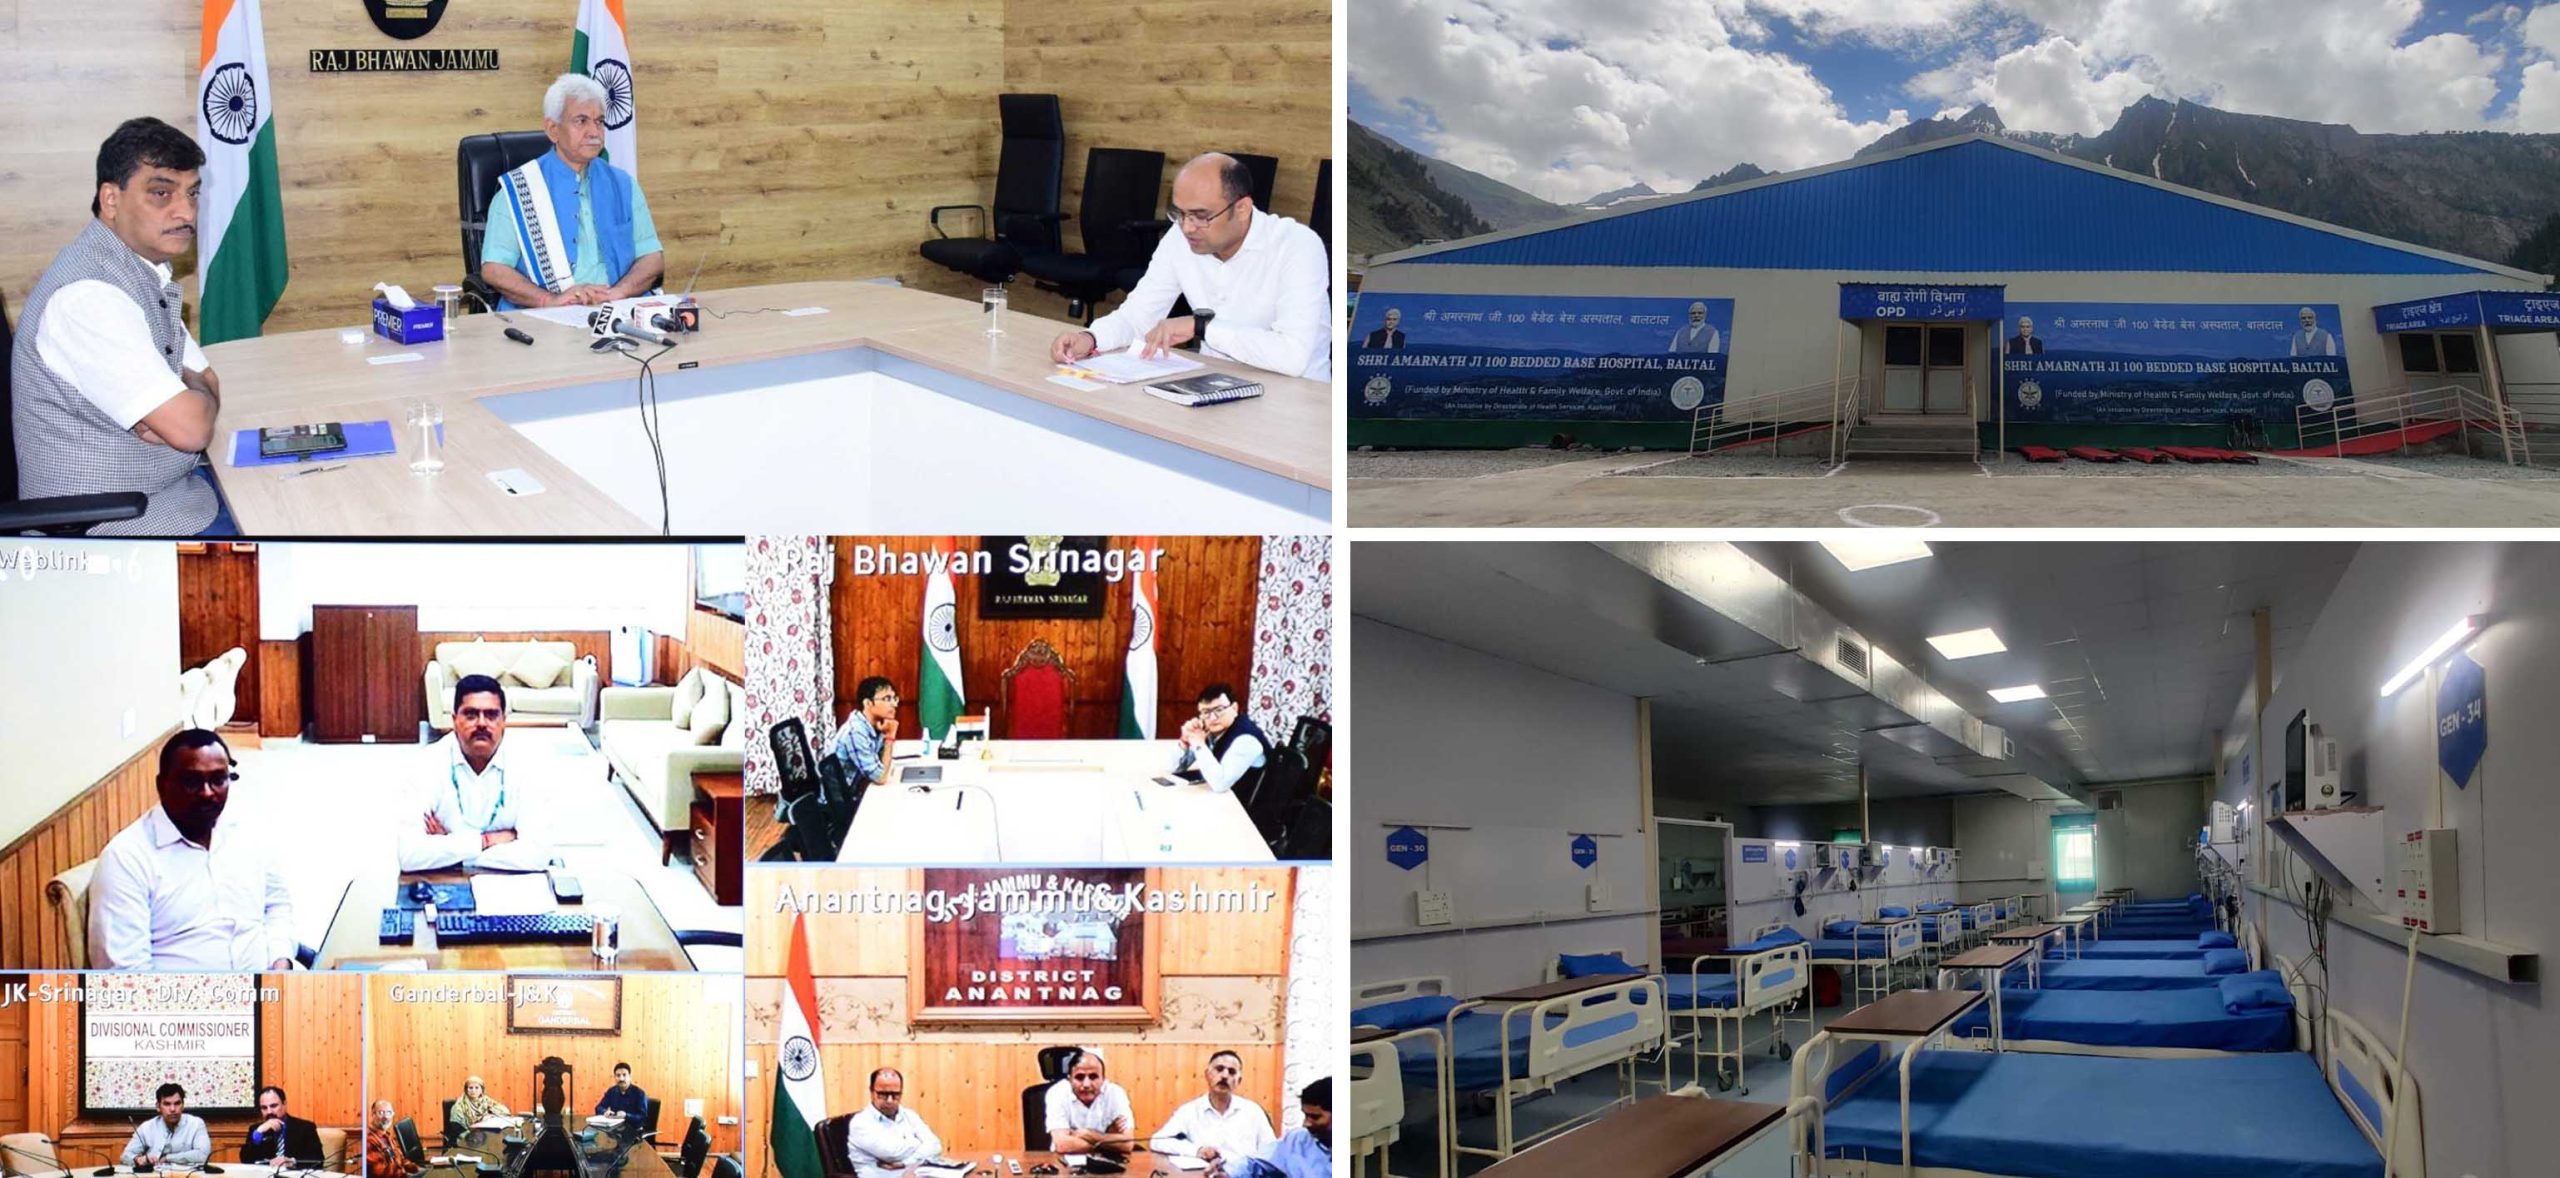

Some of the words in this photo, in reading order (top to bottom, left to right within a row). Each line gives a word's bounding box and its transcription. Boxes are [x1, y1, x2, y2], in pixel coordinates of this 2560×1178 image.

[312, 50, 350, 71] RAJ
[355, 50, 430, 71] BHAWAN
[434, 50, 500, 70] JAMMU
[1904, 288, 1927, 303] रोगी
[1931, 289, 1966, 303] विभाग
[1507, 313, 1525, 323] 100
[1876, 306, 1906, 317] OPD
[374, 308, 403, 331] PREMIER
[595, 305, 614, 335] ANI
[2132, 320, 2149, 330] 100
[2497, 315, 2533, 323] TRIAGE
[2534, 315, 2560, 324] AREA
[1357, 355, 1389, 366] SHRI
[1391, 355, 1466, 368] AMARNATH
[1469, 356, 1483, 368] JI
[1485, 356, 1508, 368] 100
[1509, 356, 1561, 368] BEDDED
[1563, 357, 1596, 369] BASE
[1599, 358, 1664, 371] HOSPITAL,
[1666, 359, 1716, 371] BALTAL
[2004, 361, 2032, 372] SHRI
[2036, 361, 2106, 372] AMARNATH
[2108, 361, 2120, 372] JI
[2124, 362, 2143, 373] 100
[2146, 362, 2193, 373] BEDDED
[2196, 362, 2227, 373] BASE
[2229, 362, 2291, 375] HOSPITAL,
[2292, 362, 2339, 373] BALTAL
[1441, 385, 1452, 396] by
[1452, 385, 1488, 396] Ministry
[1489, 385, 1498, 395] of
[1500, 386, 1528, 396] Health
[1538, 387, 1567, 397] Family
[1627, 387, 1637, 397] of
[2088, 389, 2099, 400] by
[2100, 389, 2133, 400] Ministry
[2133, 390, 2142, 399] of
[2143, 390, 2171, 400] Health
[2179, 390, 2206, 401] Family
[2263, 390, 2272, 399] of
[784, 544, 835, 585] Raj
[854, 543, 992, 575] Bhawan
[1008, 543, 1165, 583] Srinagar
[2440, 710, 2460, 737] GEN
[2467, 699, 2481, 724] 34
[1390, 844, 1408, 852] GEN
[971, 970, 1095, 983] DISTRICT
[0, 983, 137, 1008] JK-Srinagar
[211, 984, 281, 1004] Comm
[390, 983, 560, 1009] Ganderbal-J&K
[945, 986, 1122, 1001] ANANTNAG
[90, 1022, 156, 1038] DIVISIONAL
[159, 1022, 249, 1037] COMMISSIONER
[134, 1039, 206, 1051] KASHMIR
